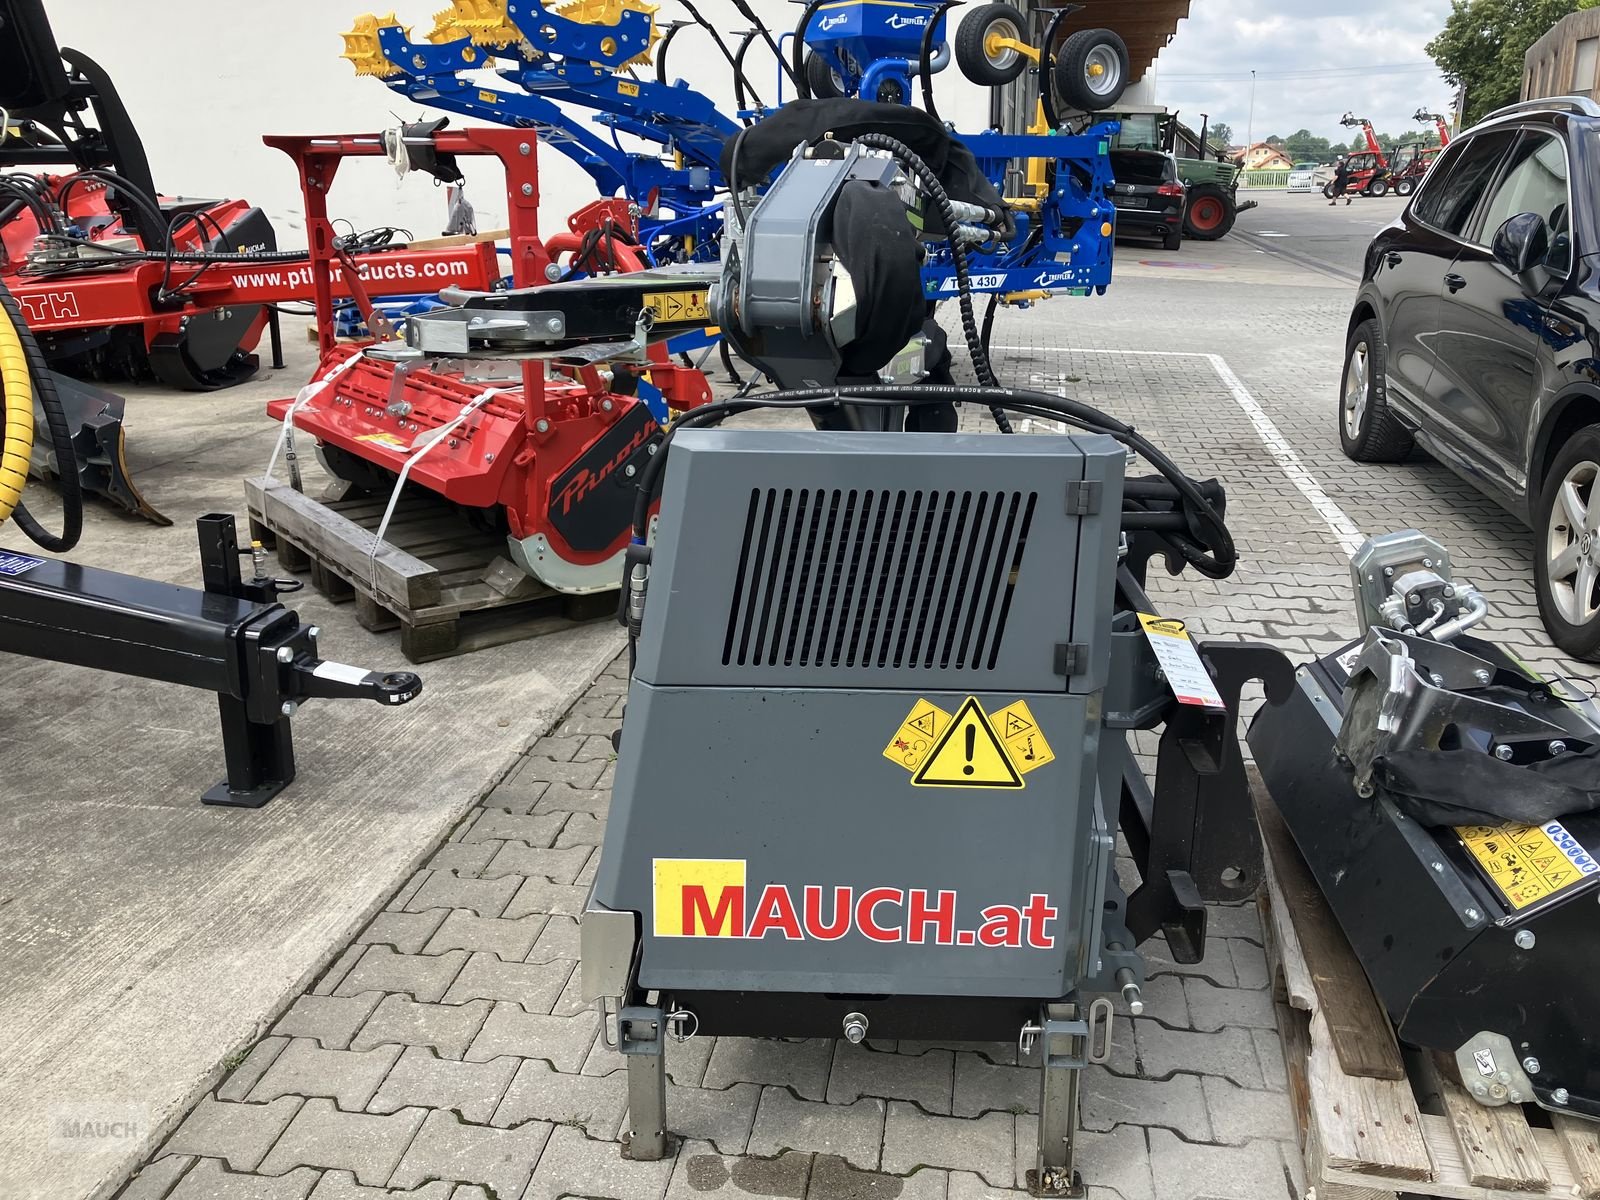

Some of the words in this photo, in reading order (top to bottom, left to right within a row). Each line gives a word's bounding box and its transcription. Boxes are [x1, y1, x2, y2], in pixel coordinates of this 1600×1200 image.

[13, 292, 80, 320] TH
[950, 278, 974, 289] TA
[977, 276, 997, 287] 430
[551, 420, 657, 516] Prinoth
[680, 883, 1059, 949] MAUCH.at
